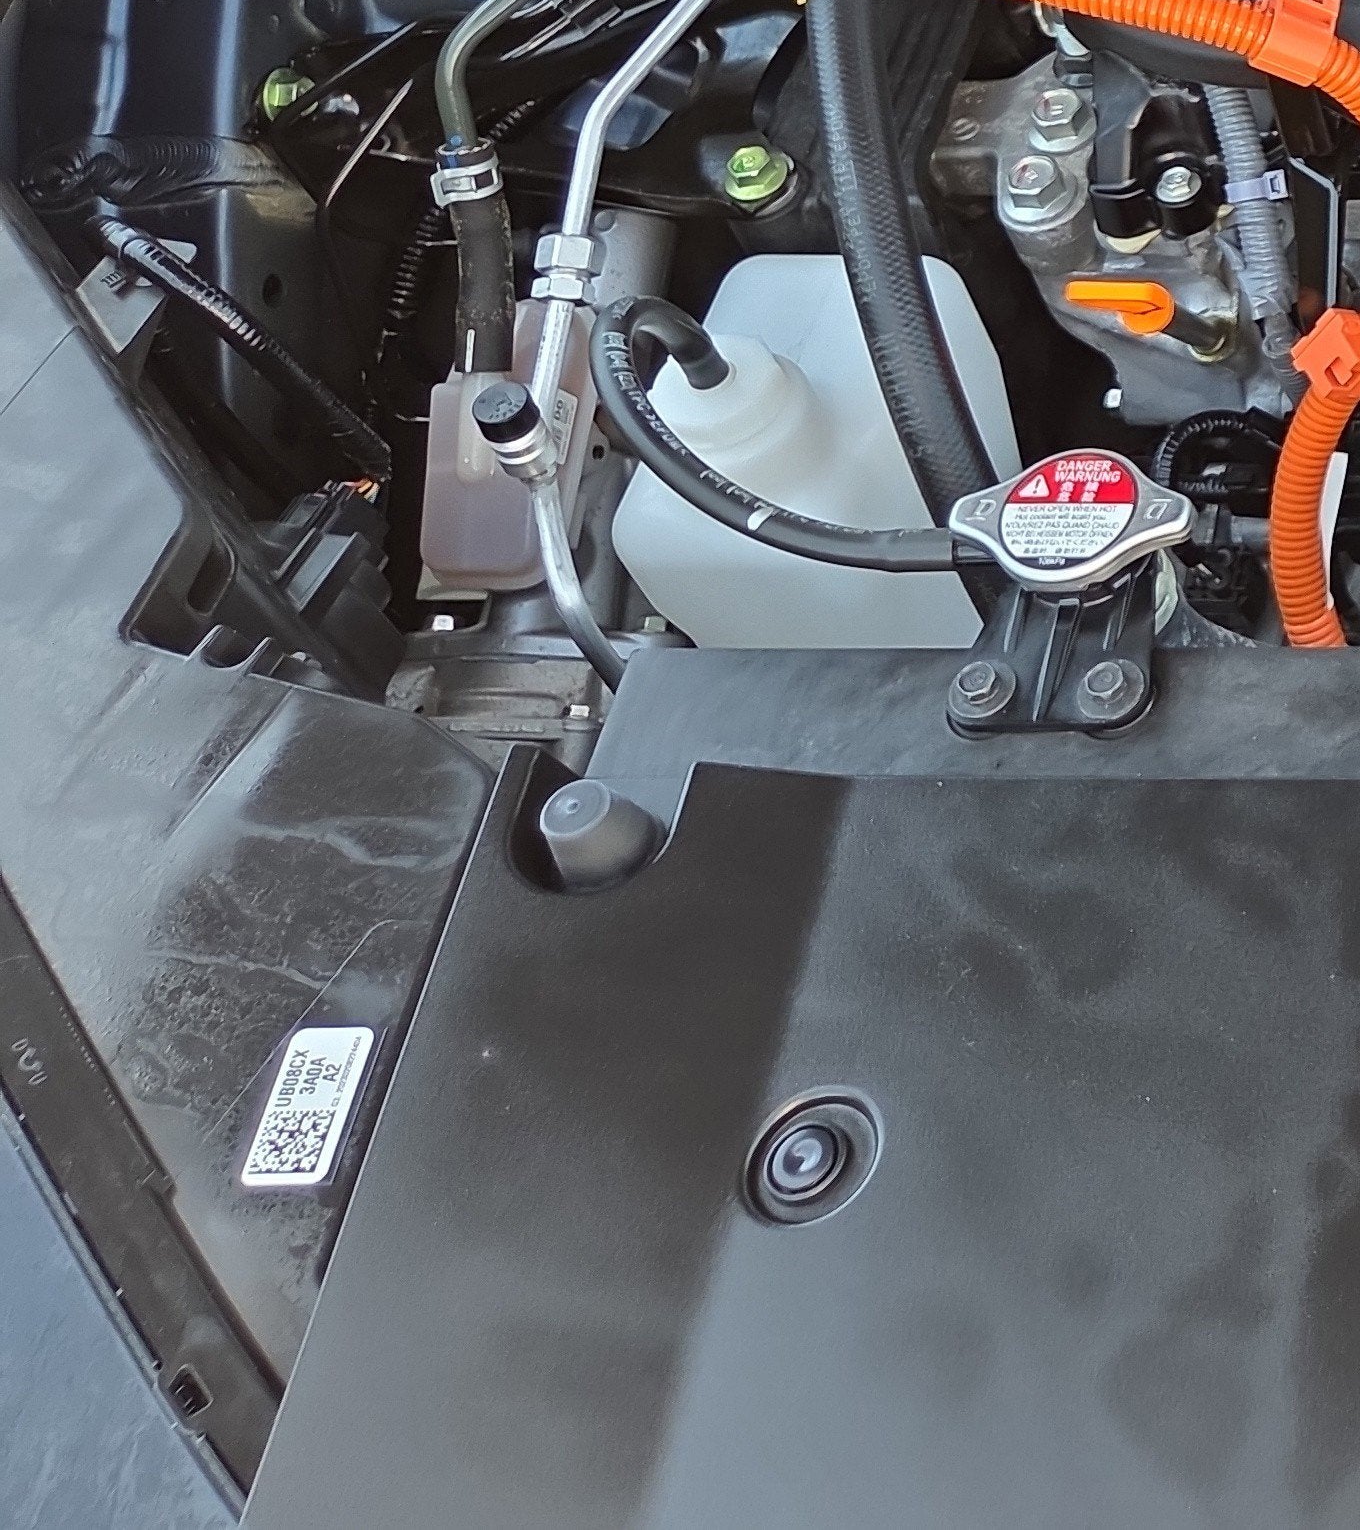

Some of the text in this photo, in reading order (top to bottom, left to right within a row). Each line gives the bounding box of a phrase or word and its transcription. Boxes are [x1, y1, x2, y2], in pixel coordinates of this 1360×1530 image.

[1057, 460, 1113, 470] DANGER
[1055, 470, 1122, 483] WARNUNG
[1018, 505, 1118, 513] NEVER OPEN WHEN HOT
[1045, 521, 1061, 529] PAS
[1062, 521, 1091, 529] QUAND
[275, 1049, 310, 1108] UB08CX
[300, 1057, 328, 1095] 3A0A
[322, 1063, 342, 1083] A2
